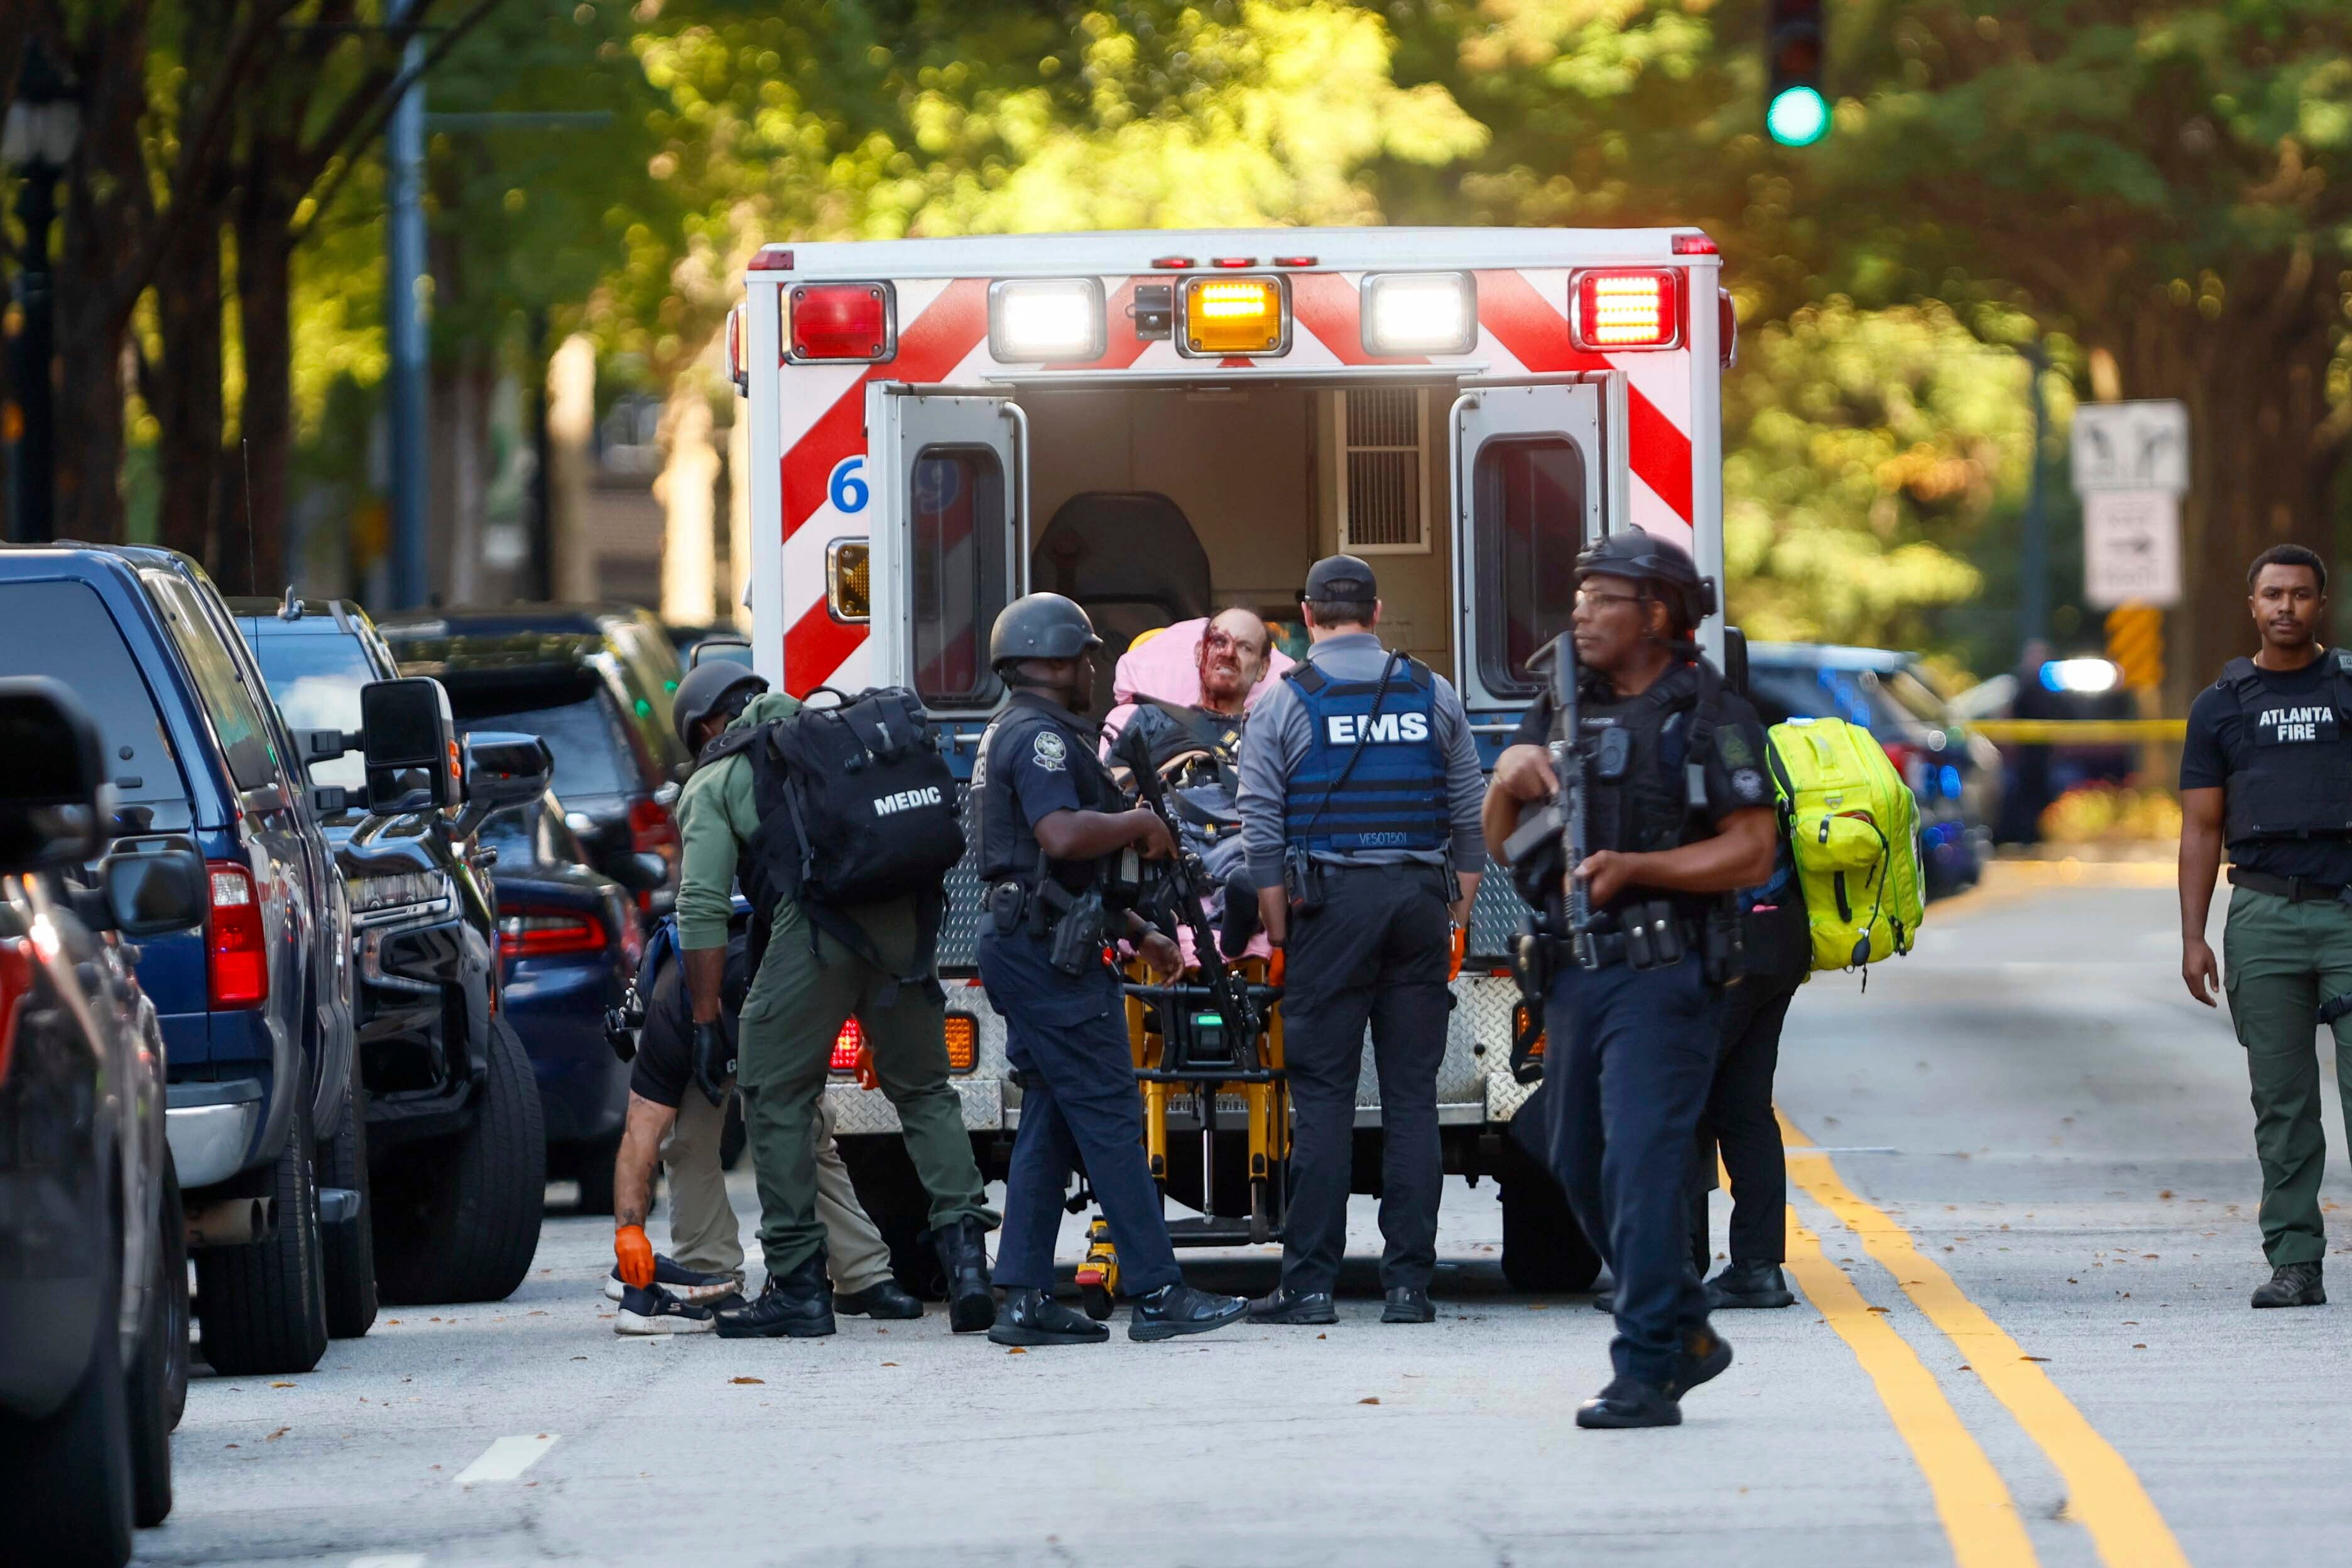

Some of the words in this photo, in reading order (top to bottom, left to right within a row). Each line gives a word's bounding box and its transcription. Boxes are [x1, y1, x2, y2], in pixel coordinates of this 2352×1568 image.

[830, 458, 869, 513] 6
[1328, 712, 1428, 744] EMS
[2260, 707, 2333, 726] ATLANTA
[2277, 723, 2316, 741] FIRE
[874, 786, 941, 816] MEDIC
